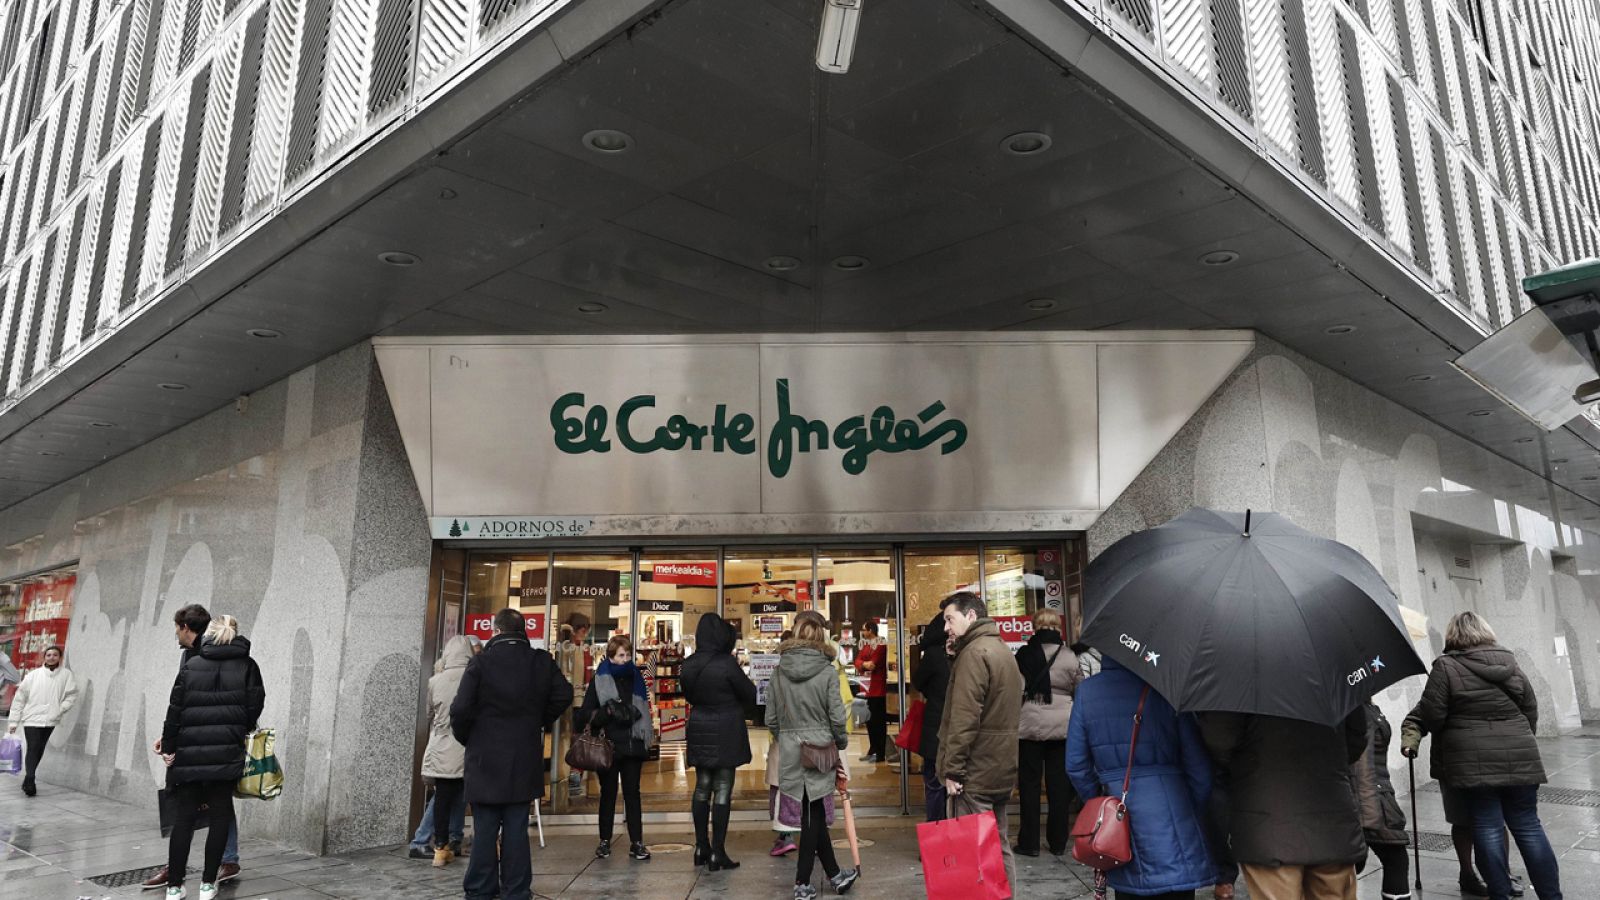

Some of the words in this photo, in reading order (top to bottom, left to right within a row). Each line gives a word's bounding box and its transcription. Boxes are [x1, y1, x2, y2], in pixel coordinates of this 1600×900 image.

[550, 392, 610, 454] El
[616, 395, 756, 455] Corte
[768, 378, 968, 478] Inglés
[480, 520, 565, 533] ADORNOS
[569, 520, 584, 532] de
[655, 564, 703, 576] merkealdia
[521, 587, 548, 597] SEPHOR
[562, 586, 611, 596] SEPHORA
[652, 602, 670, 610] Dior
[996, 617, 1033, 632] reba
[1119, 633, 1140, 652] can
[1347, 666, 1367, 686] can
